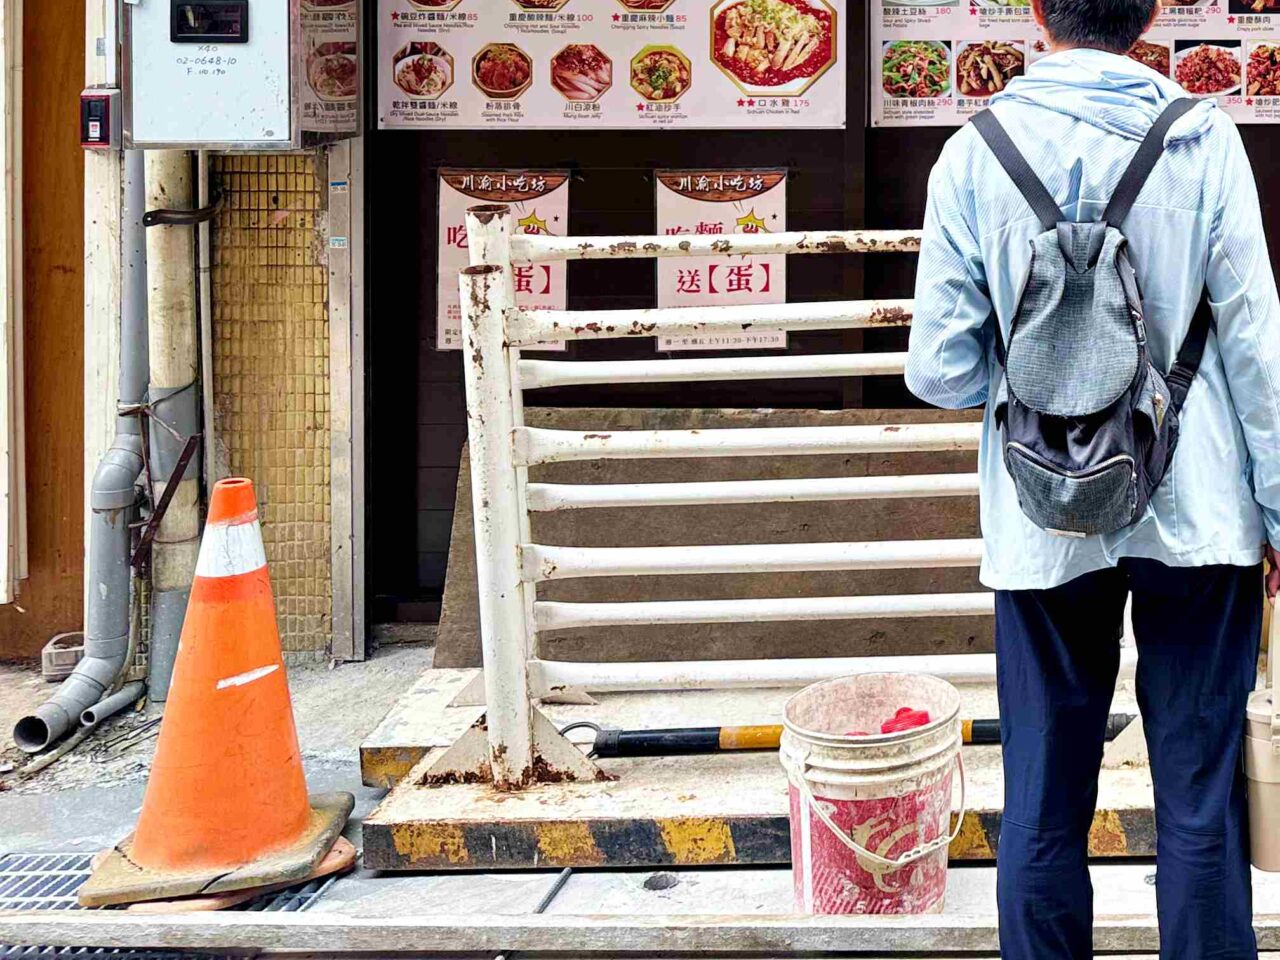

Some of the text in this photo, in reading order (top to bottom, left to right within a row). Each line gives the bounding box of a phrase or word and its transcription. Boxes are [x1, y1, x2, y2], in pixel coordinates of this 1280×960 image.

[936, 7, 951, 15] 180
[1205, 6, 1221, 14] 290
[467, 13, 478, 21] 85
[577, 14, 594, 22] 100
[792, 99, 810, 108] 175
[936, 98, 953, 107] 290
[1226, 96, 1242, 104] 350
[461, 175, 546, 191] 川渝小吃坊
[679, 175, 764, 191] 川渝小吃坊
[677, 264, 770, 294] 送【蛋】
